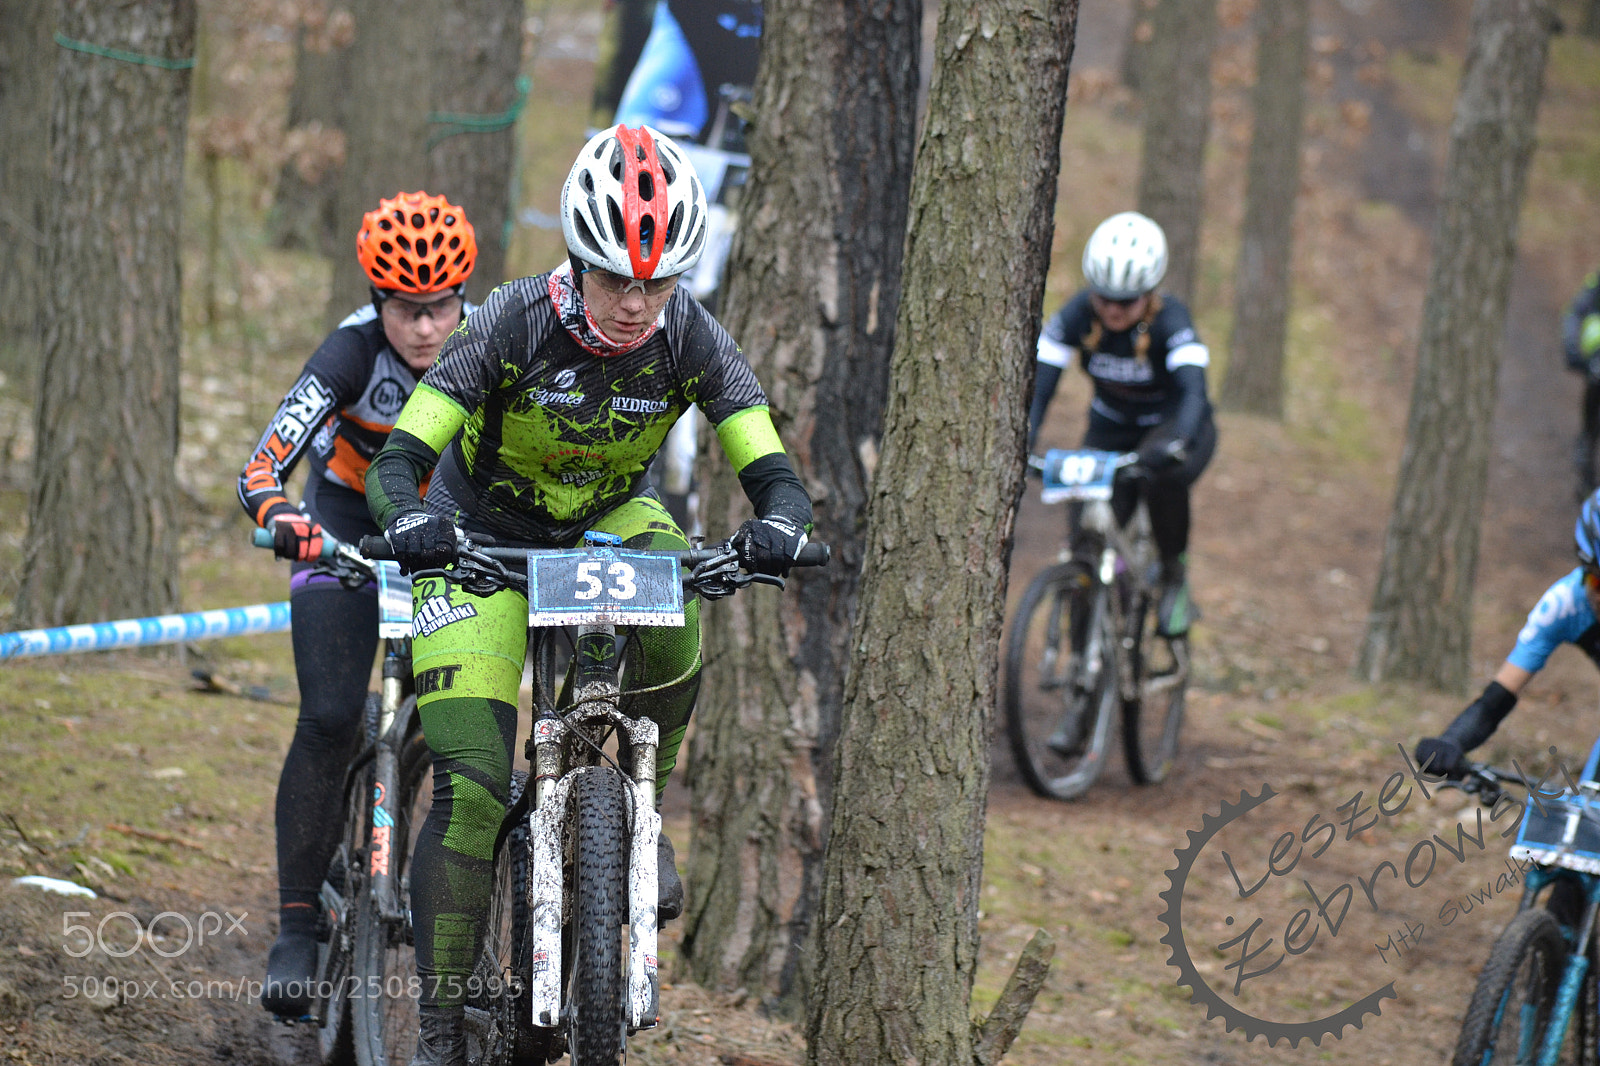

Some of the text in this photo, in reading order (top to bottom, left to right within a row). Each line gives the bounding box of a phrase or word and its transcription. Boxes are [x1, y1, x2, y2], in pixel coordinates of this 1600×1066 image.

[611, 396, 669, 413] HYDRON
[574, 562, 637, 600] 53
[412, 595, 451, 638] mtb
[370, 825, 391, 877] FOX
